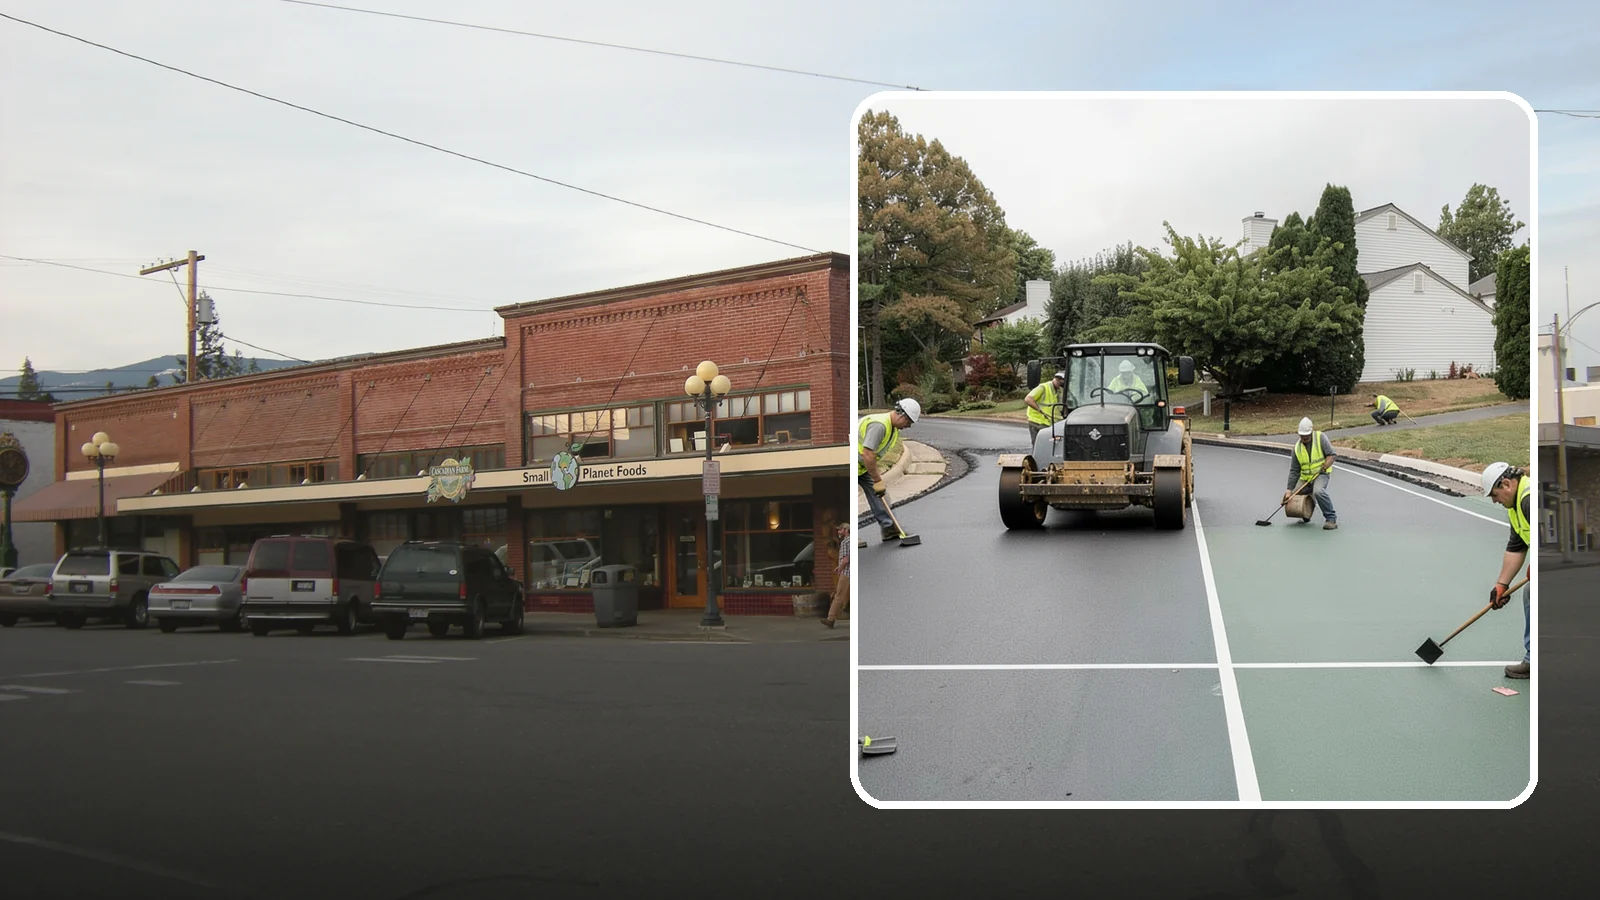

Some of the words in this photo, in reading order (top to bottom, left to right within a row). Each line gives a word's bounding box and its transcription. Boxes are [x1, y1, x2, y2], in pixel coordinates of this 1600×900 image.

[523, 471, 548, 483] Small
[583, 468, 613, 479] Planet
[617, 464, 647, 477] Foods
